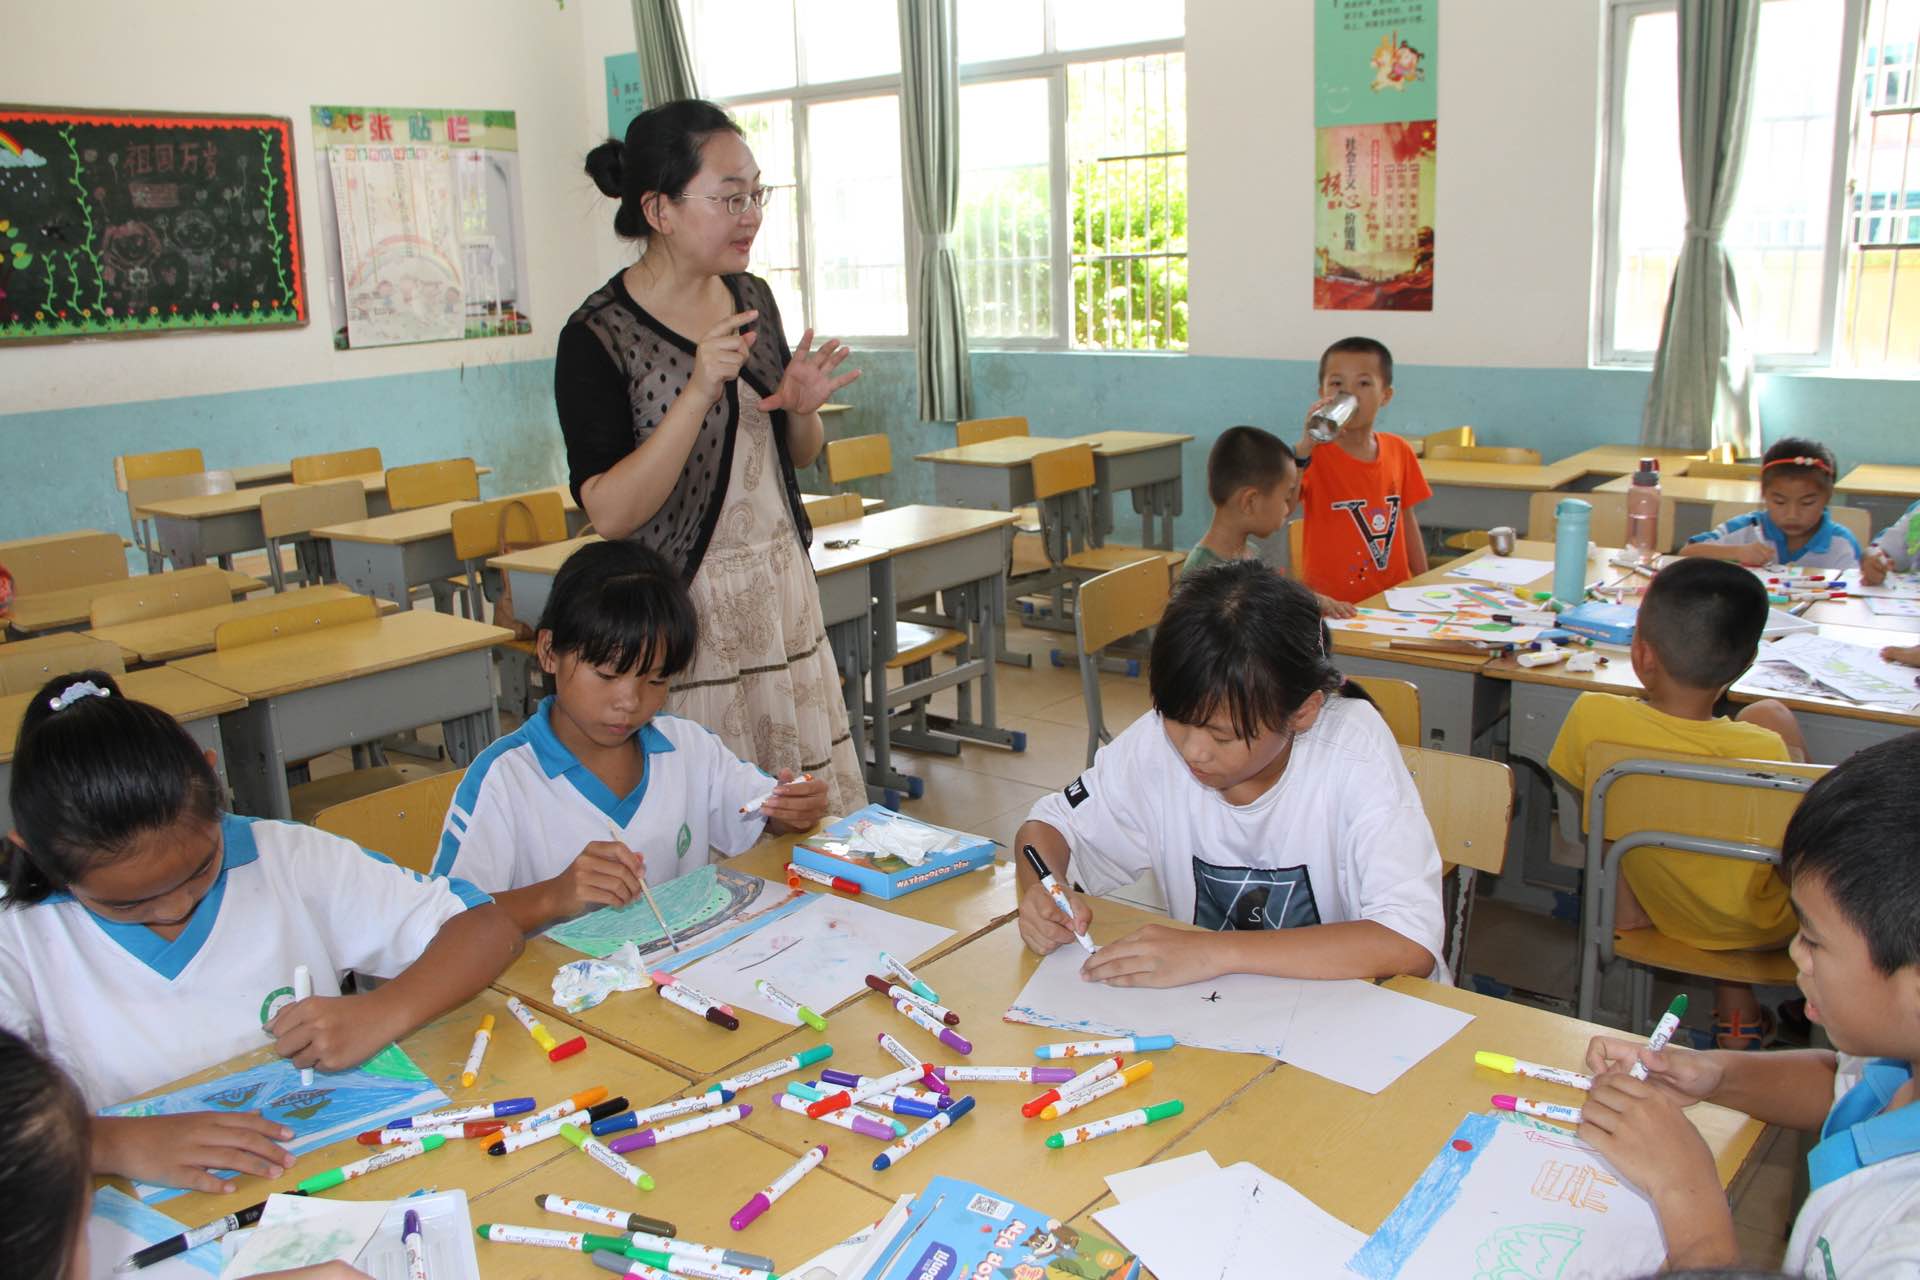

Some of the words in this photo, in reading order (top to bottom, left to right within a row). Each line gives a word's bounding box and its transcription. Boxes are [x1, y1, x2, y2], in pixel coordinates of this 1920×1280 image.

[369, 112, 471, 143] 张贴栏
[124, 141, 217, 179] 祖国万岁
